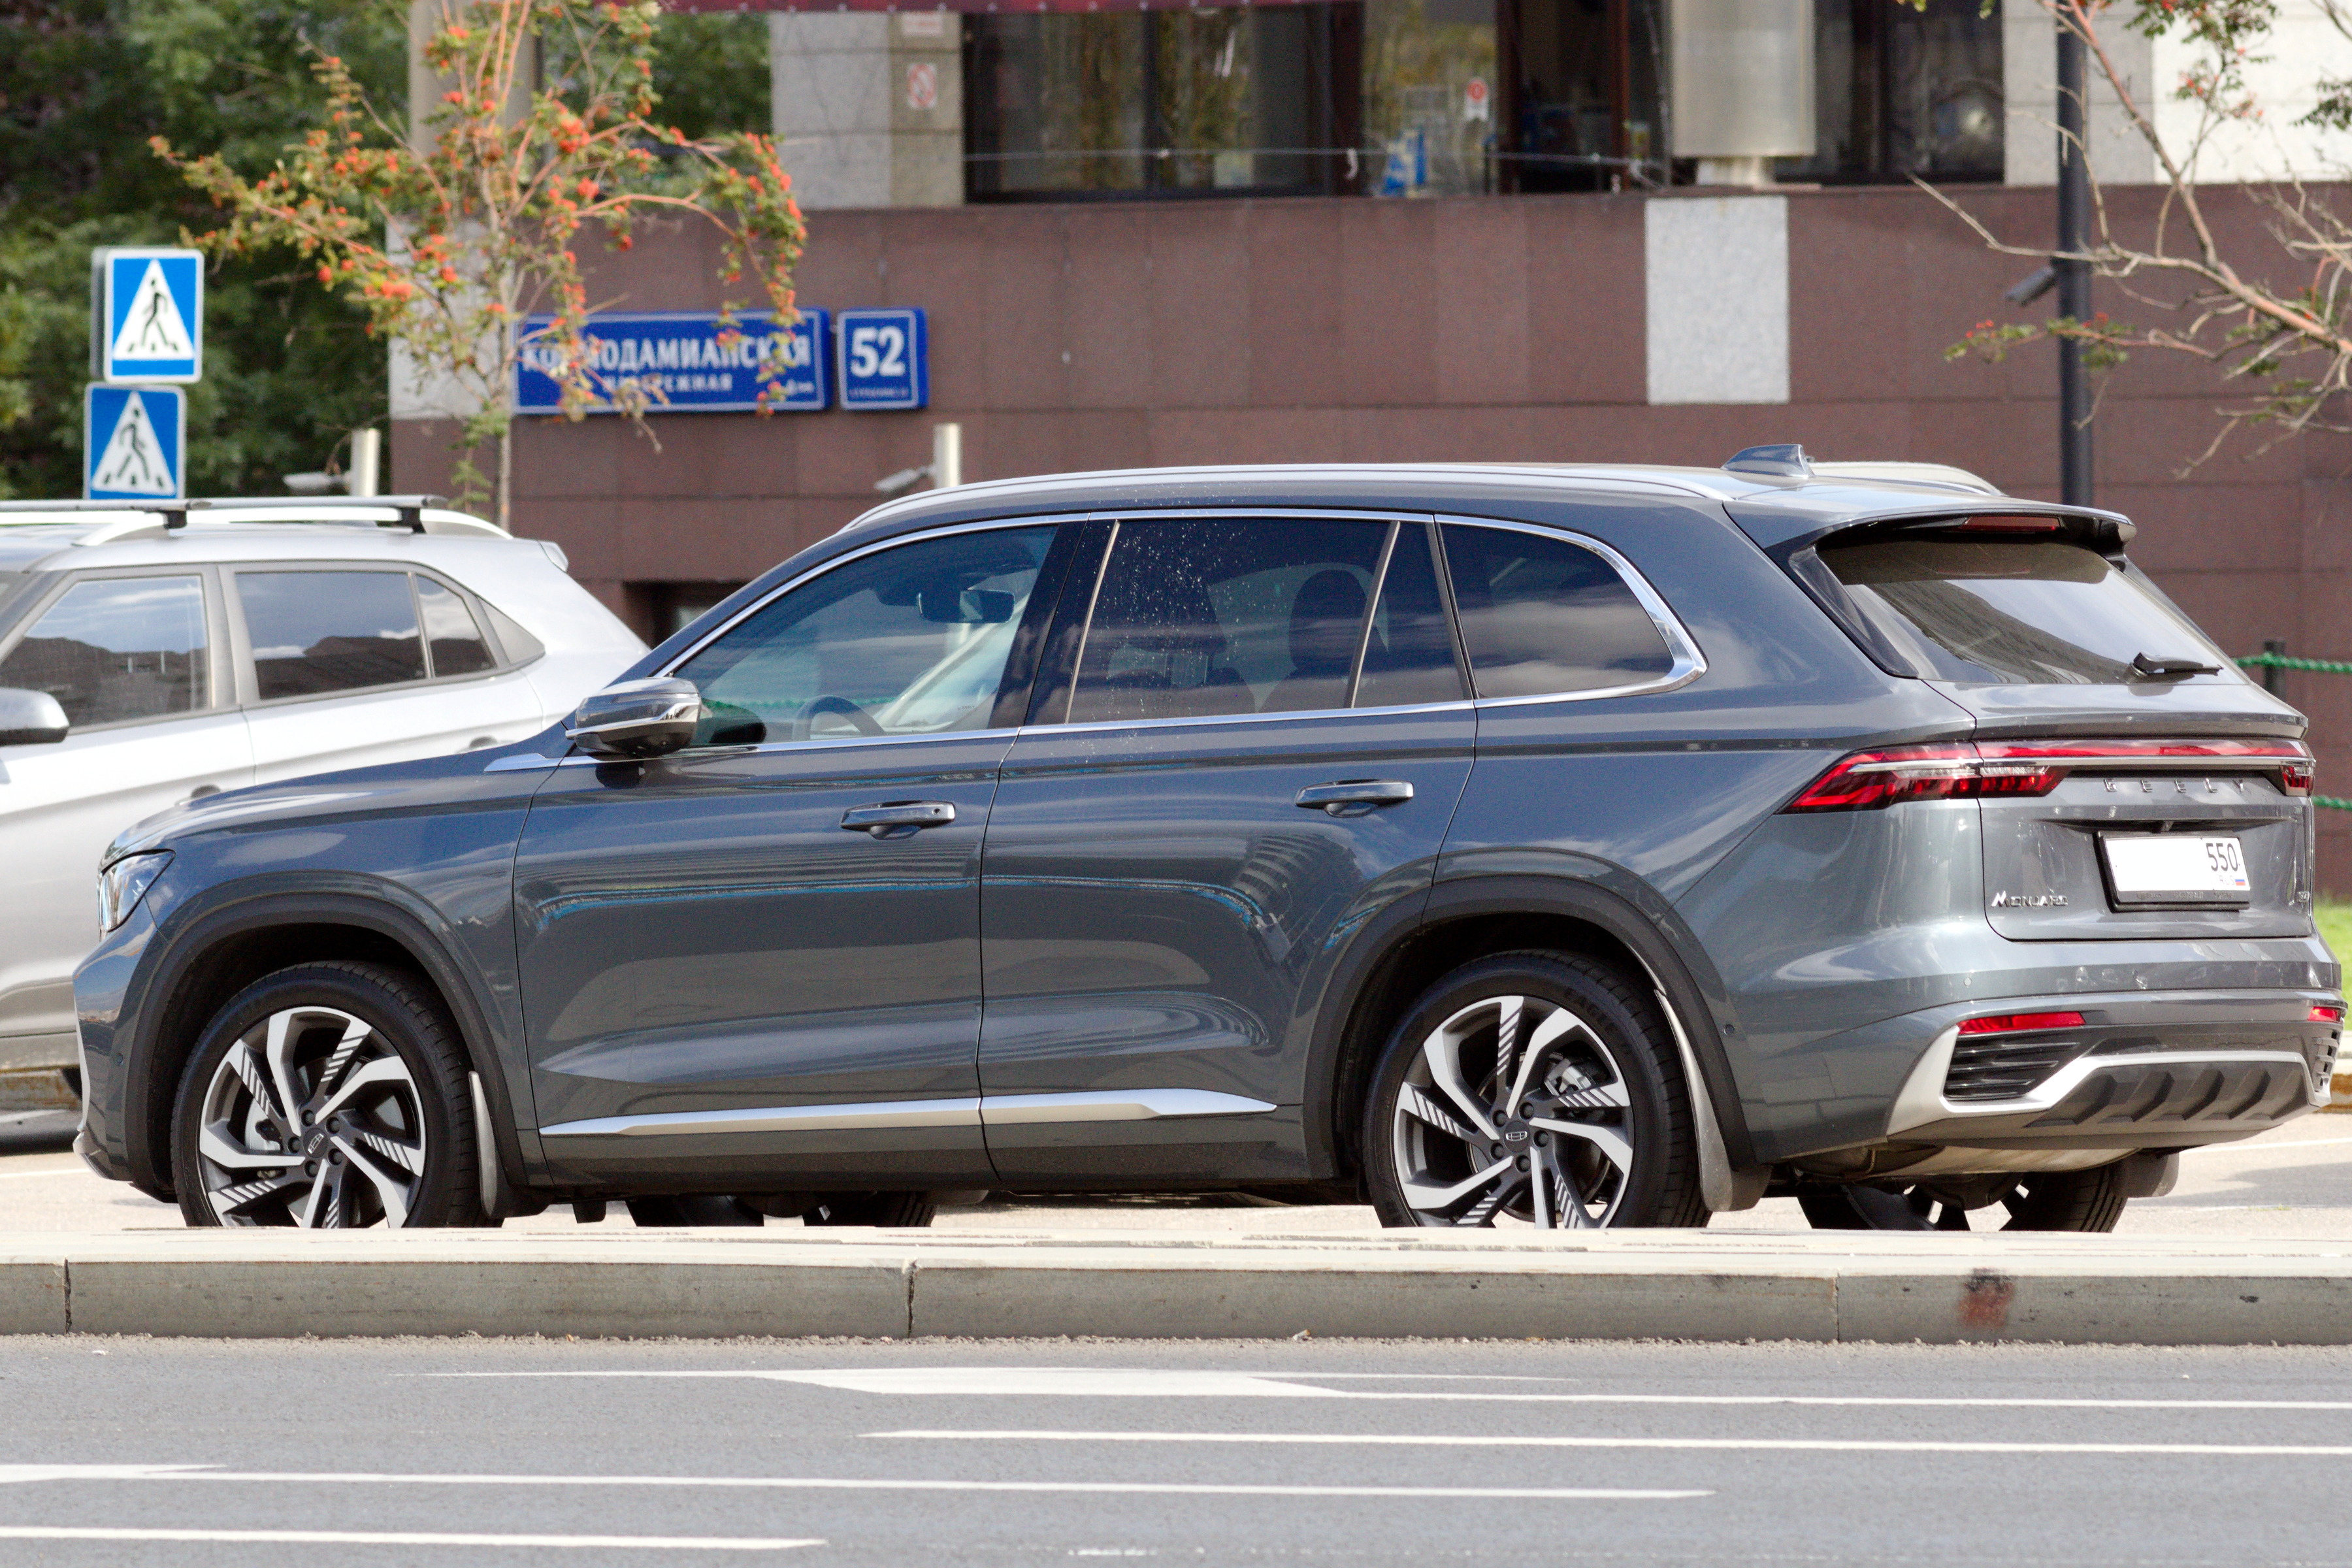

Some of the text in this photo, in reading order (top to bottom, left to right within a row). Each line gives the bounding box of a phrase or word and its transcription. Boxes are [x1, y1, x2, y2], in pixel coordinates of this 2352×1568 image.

[523, 335, 810, 372] КООДАМИАНСКЯ
[851, 326, 906, 378] 52
[2103, 777, 2247, 794] GEELY
[2206, 843, 2238, 872] 550
[2219, 875, 2235, 886] RUS
